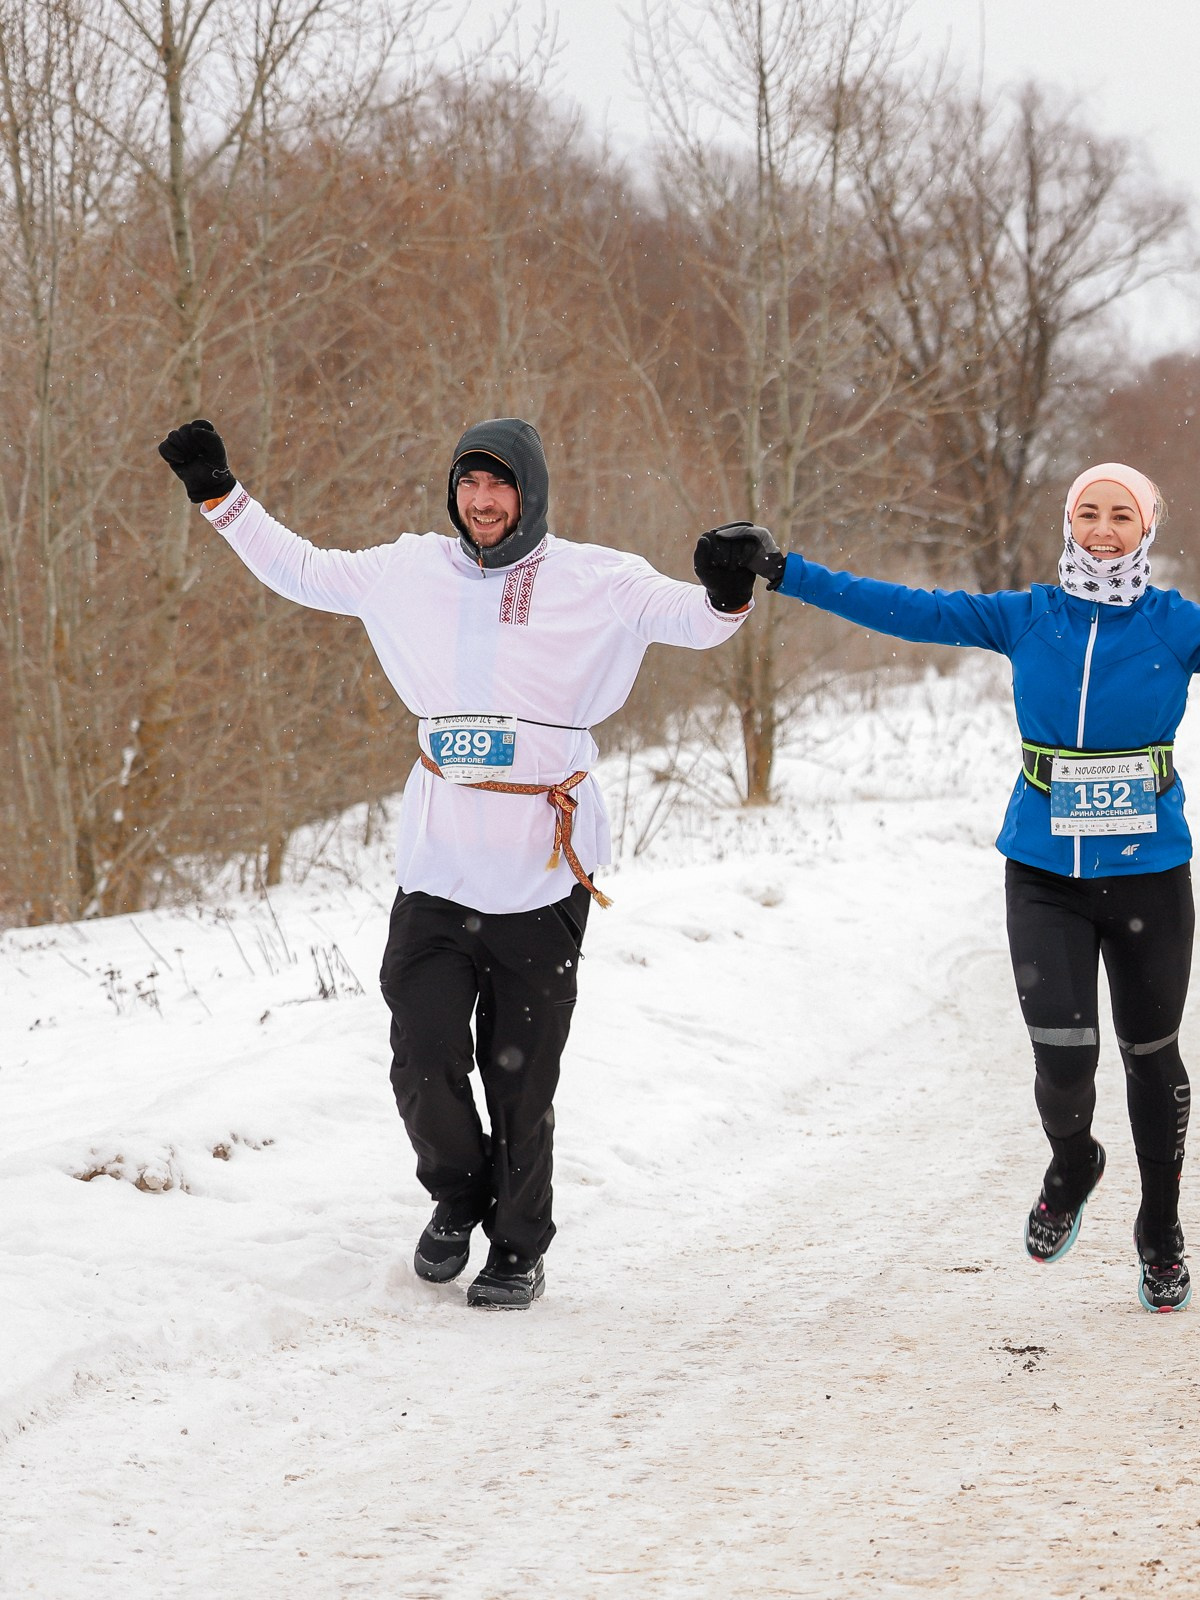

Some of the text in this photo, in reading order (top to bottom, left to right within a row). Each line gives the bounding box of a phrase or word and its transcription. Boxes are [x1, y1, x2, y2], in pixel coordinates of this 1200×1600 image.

[440, 731, 492, 757] 289
[1074, 764, 1130, 775] NOVGOROD ICE
[1074, 782, 1132, 810] 152
[1095, 808, 1138, 816] АРСЕНЬЕВА
[1121, 843, 1140, 856] 4F
